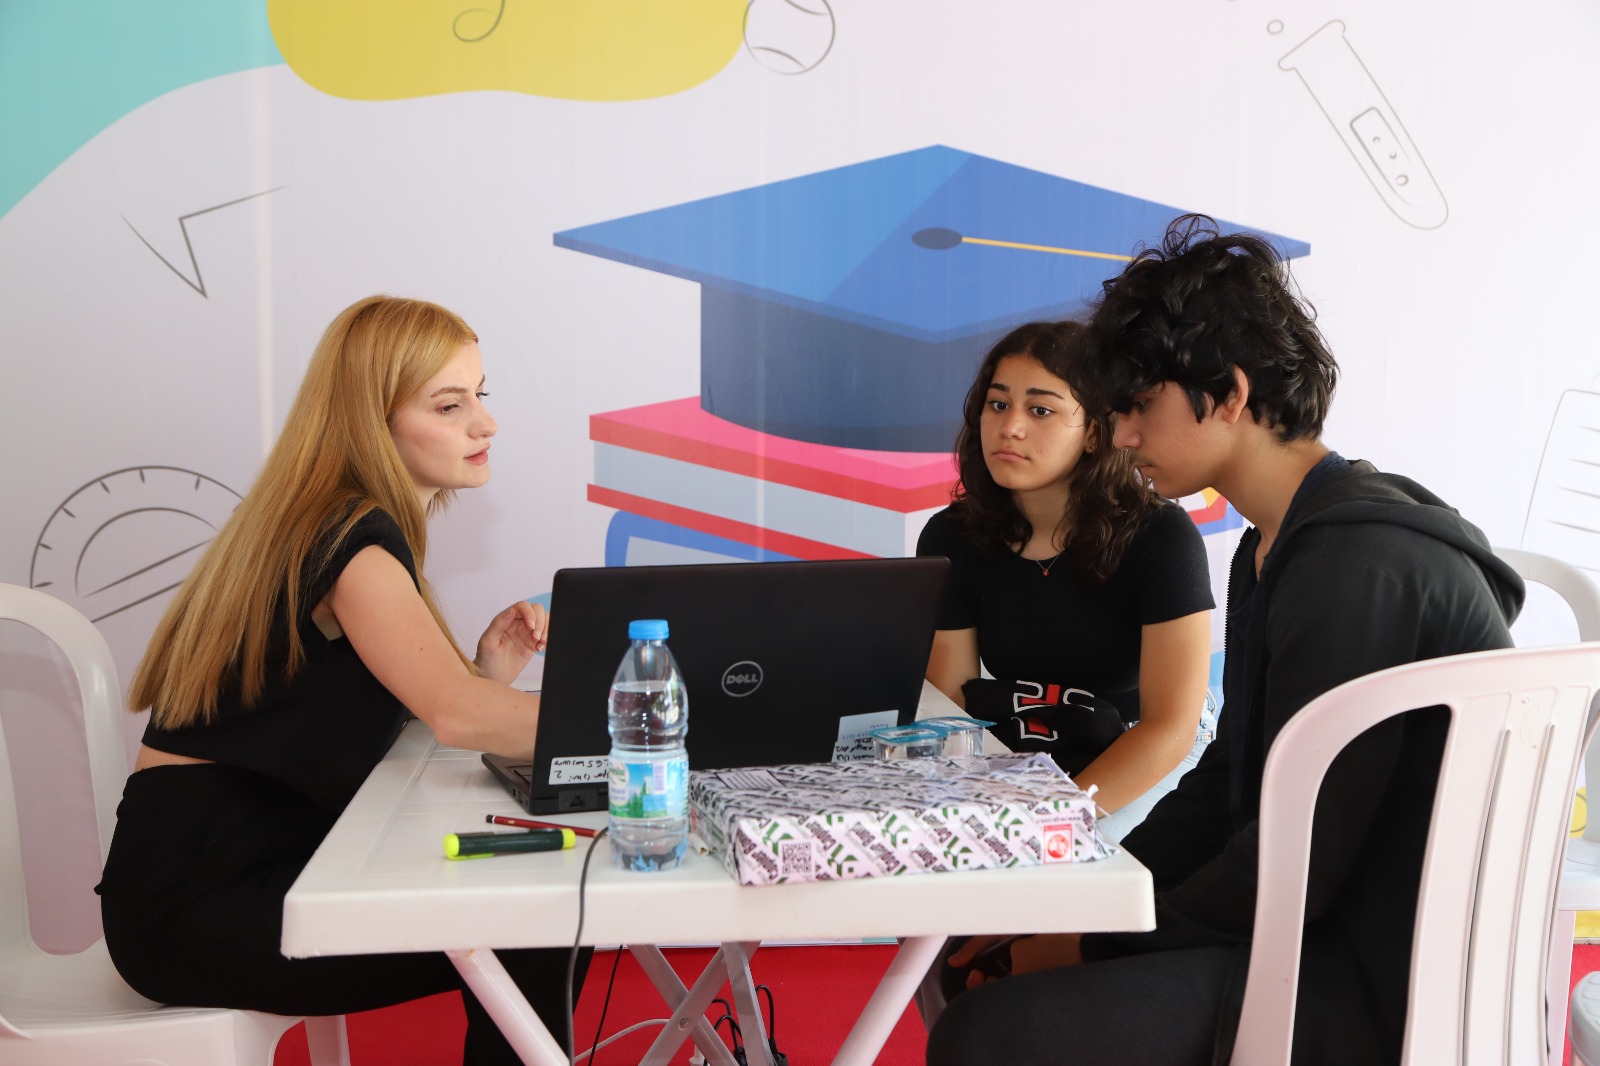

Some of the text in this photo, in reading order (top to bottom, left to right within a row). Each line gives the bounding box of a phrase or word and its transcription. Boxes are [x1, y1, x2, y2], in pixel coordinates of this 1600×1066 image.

[725, 673, 758, 685] DELL
[806, 821, 837, 852] Copier
[984, 835, 1013, 864] Copier
[752, 850, 779, 881] Copier
[870, 843, 900, 873] Copier
